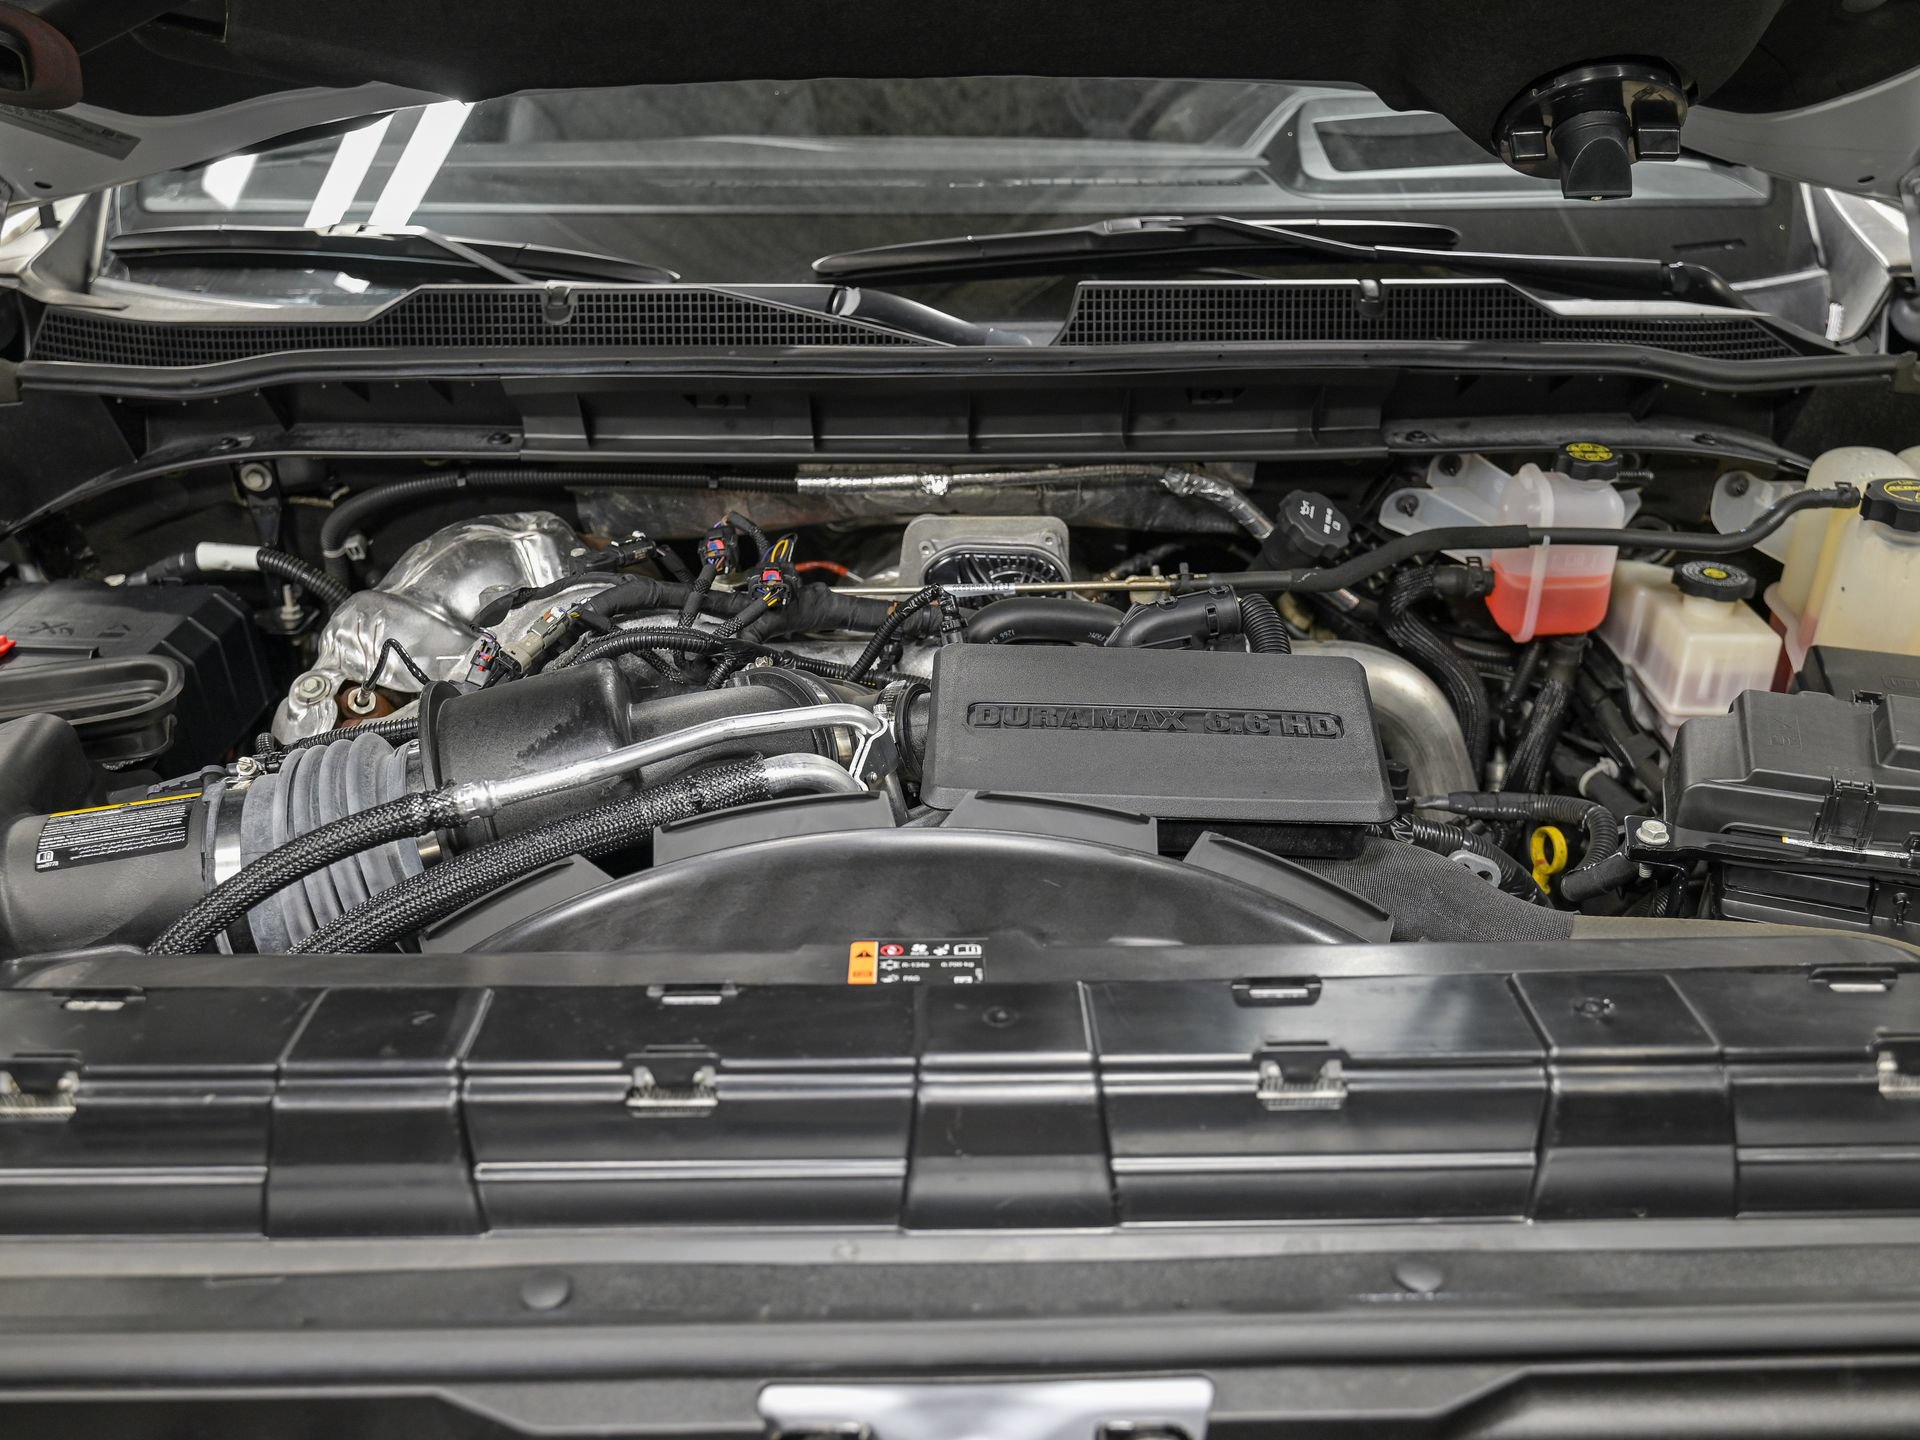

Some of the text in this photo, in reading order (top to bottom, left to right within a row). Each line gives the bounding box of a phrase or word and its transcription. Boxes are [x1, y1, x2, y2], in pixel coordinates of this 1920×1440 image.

[974, 706, 1338, 739] DURAMAX 6.6 HD
